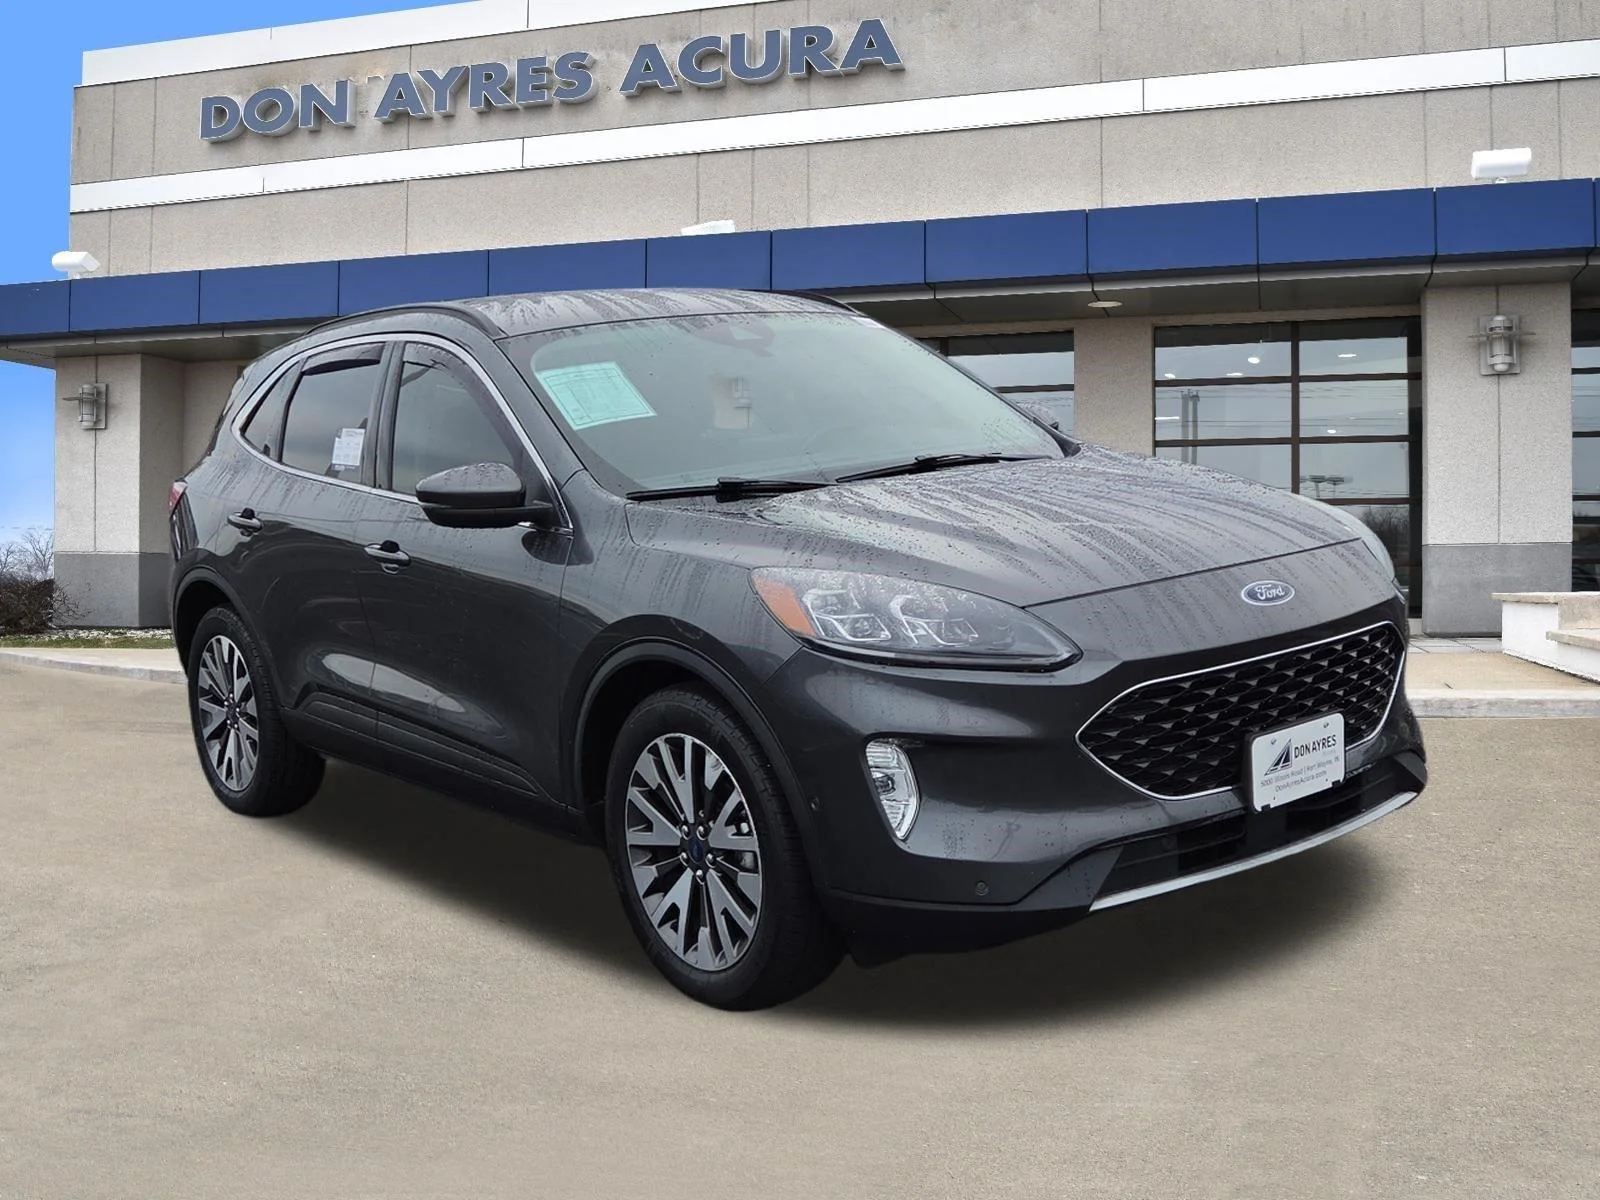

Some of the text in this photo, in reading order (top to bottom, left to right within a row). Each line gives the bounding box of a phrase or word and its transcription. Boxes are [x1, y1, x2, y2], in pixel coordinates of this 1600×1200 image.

[200, 18, 905, 143] DON AYRES ACURA
[1255, 584, 1285, 600] Ford
